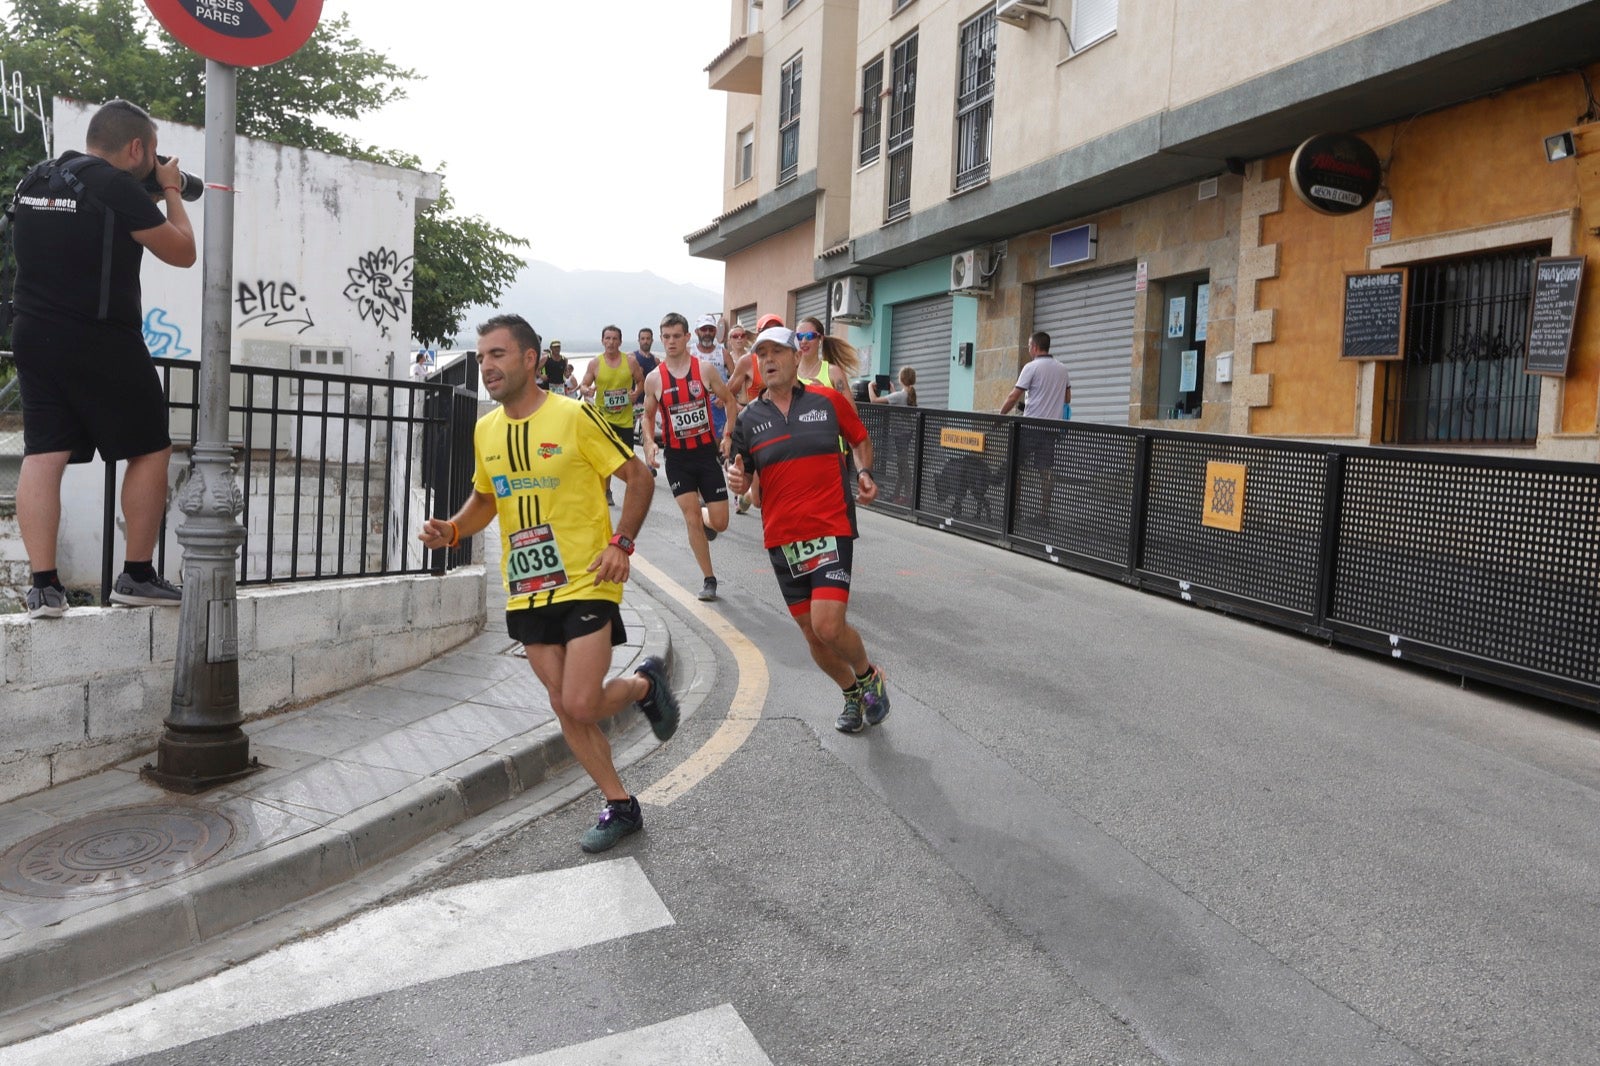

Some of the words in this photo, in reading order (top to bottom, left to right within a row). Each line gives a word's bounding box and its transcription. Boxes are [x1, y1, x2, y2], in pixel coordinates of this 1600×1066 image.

[196, 6, 240, 26] PARES
[609, 395, 625, 405] 679
[675, 409, 706, 427] 3068
[509, 544, 559, 576] 1038
